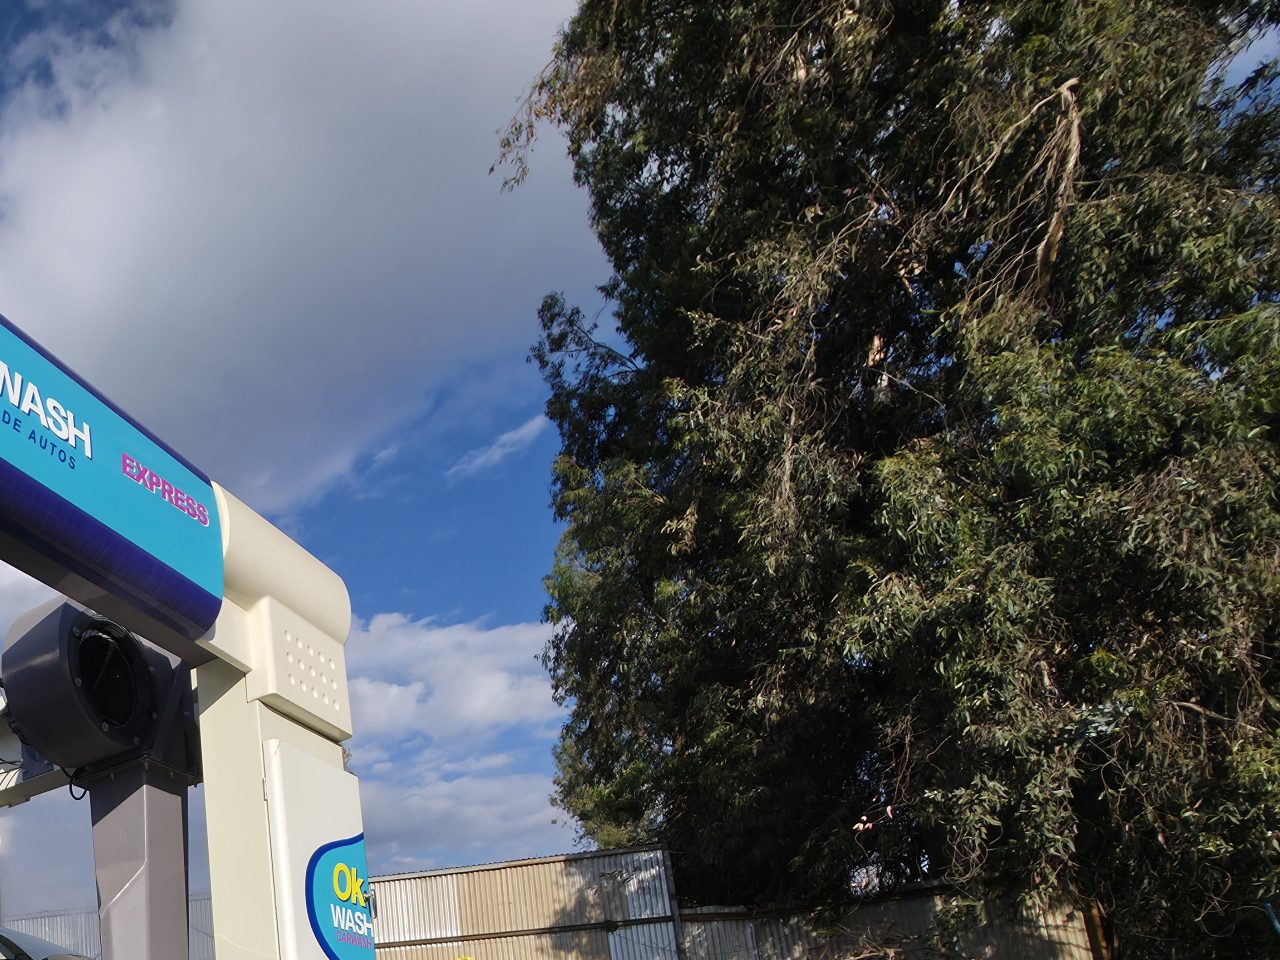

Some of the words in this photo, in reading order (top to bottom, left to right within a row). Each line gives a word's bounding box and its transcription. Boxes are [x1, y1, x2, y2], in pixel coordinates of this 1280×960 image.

[1, 409, 22, 433] DE
[27, 429, 76, 470] AUTOS
[121, 451, 210, 528] EXPRESS
[330, 903, 375, 938] WASH
